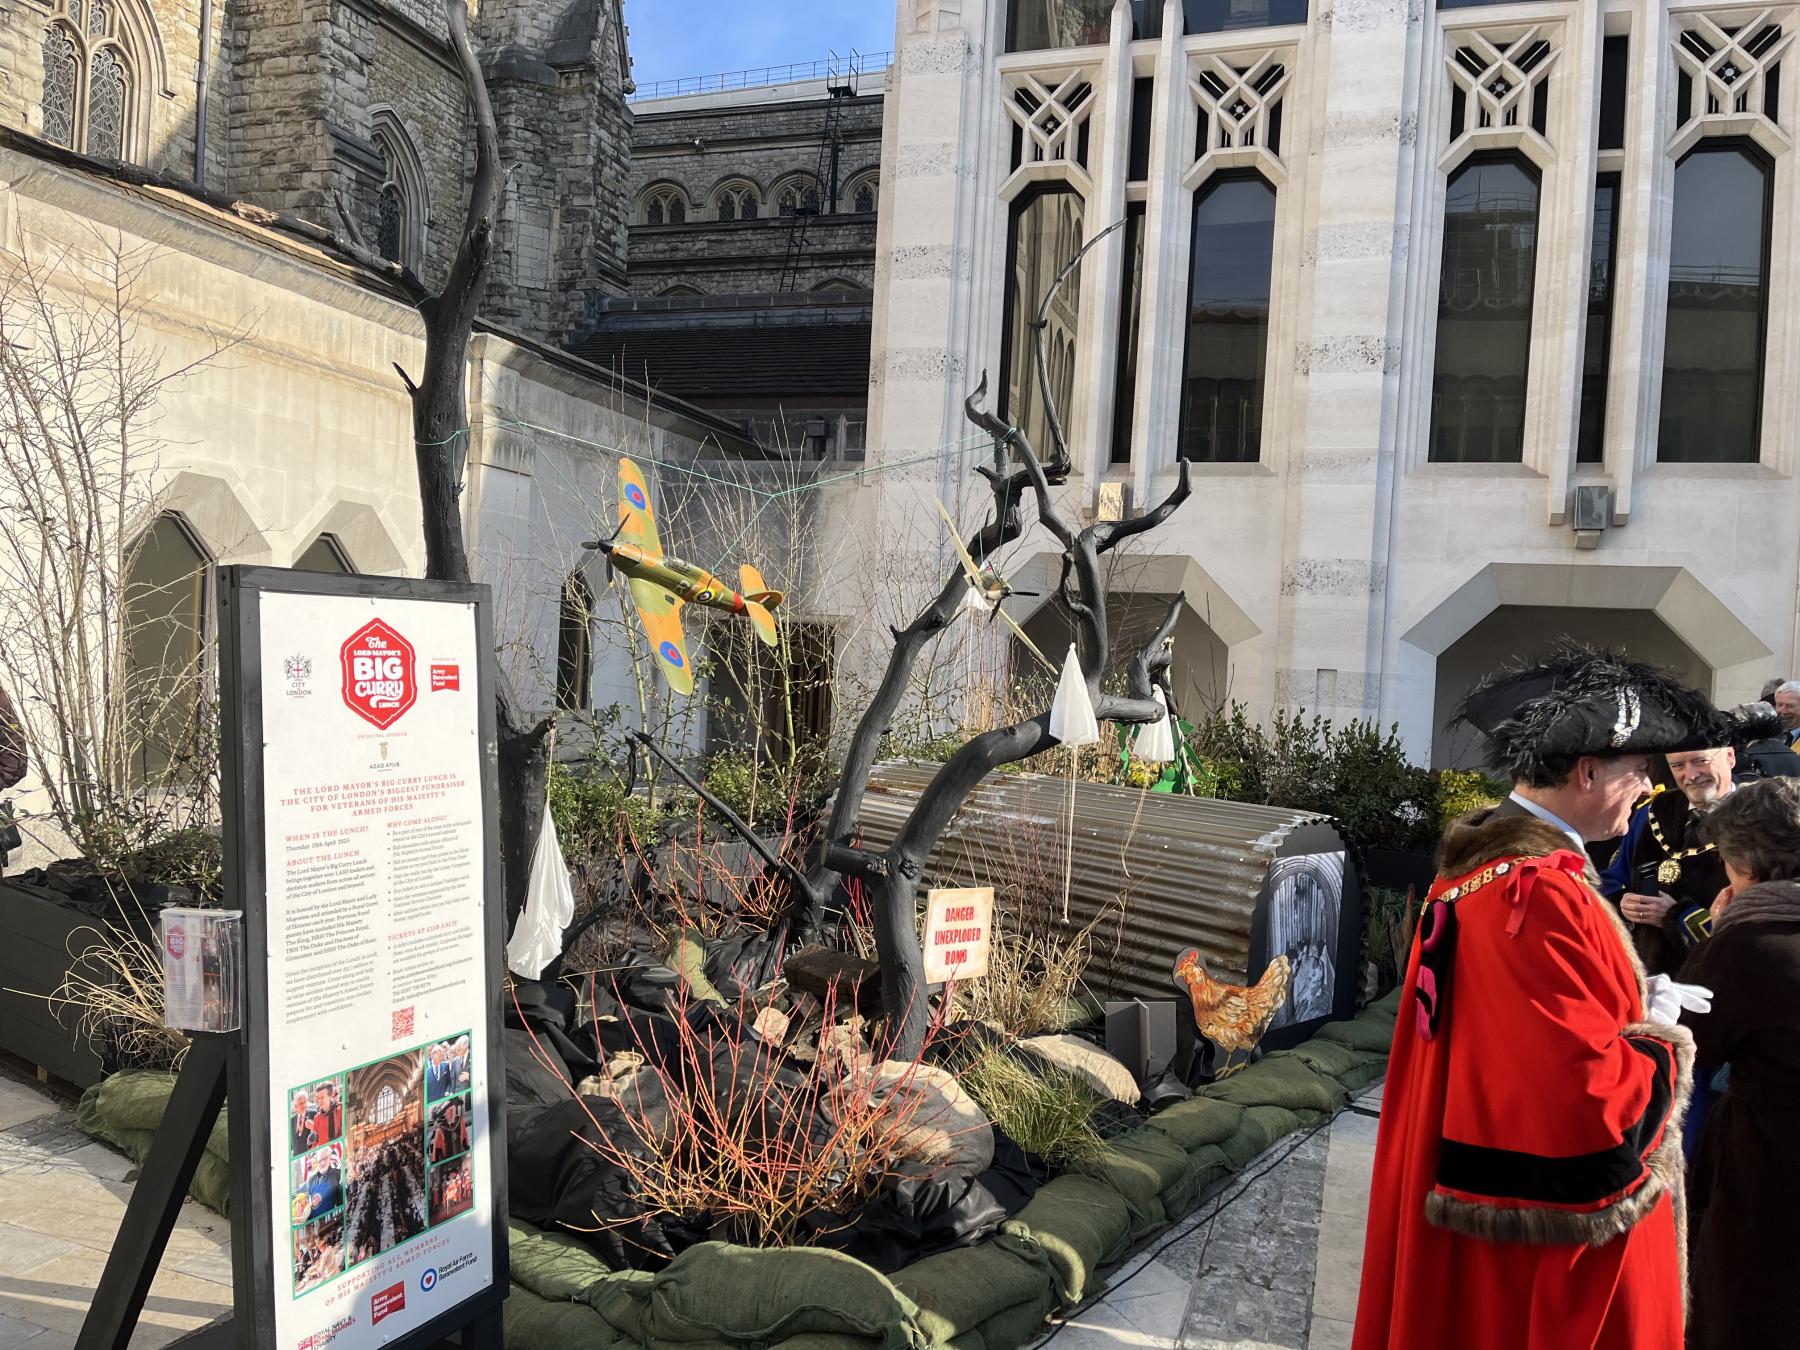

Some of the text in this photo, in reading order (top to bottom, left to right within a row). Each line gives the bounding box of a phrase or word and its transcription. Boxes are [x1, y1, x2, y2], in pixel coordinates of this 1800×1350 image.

[365, 636, 387, 649] The
[354, 657, 403, 680] BIG
[355, 680, 404, 703] CURRY
[280, 780, 465, 807] THE CITY OF LONDON'S BIGGEST FUNDRAISER
[293, 787, 312, 796] THE
[315, 785, 339, 793] LORD
[342, 781, 379, 791] MAYOR'S
[397, 777, 421, 785] CURRY
[424, 774, 447, 782] LUNCH
[310, 804, 328, 812] FOR
[331, 799, 376, 810] VETERANS
[407, 791, 445, 801] MAJESTY'S
[352, 803, 413, 816] ARMED FORCES
[403, 818, 423, 826] COME
[285, 834, 310, 842] WHEN
[322, 829, 337, 837] THE
[287, 850, 360, 867] ABOUT THE LUNCH
[945, 906, 974, 922] DANGER
[934, 927, 981, 946] UNEXPLODED
[945, 948, 967, 966] BOMB
[438, 1262, 452, 1274] Royal
[459, 1252, 473, 1263] Force
[373, 1294, 388, 1305] Army
[373, 1292, 403, 1312] Benevolent
[374, 1306, 388, 1318] Fund
